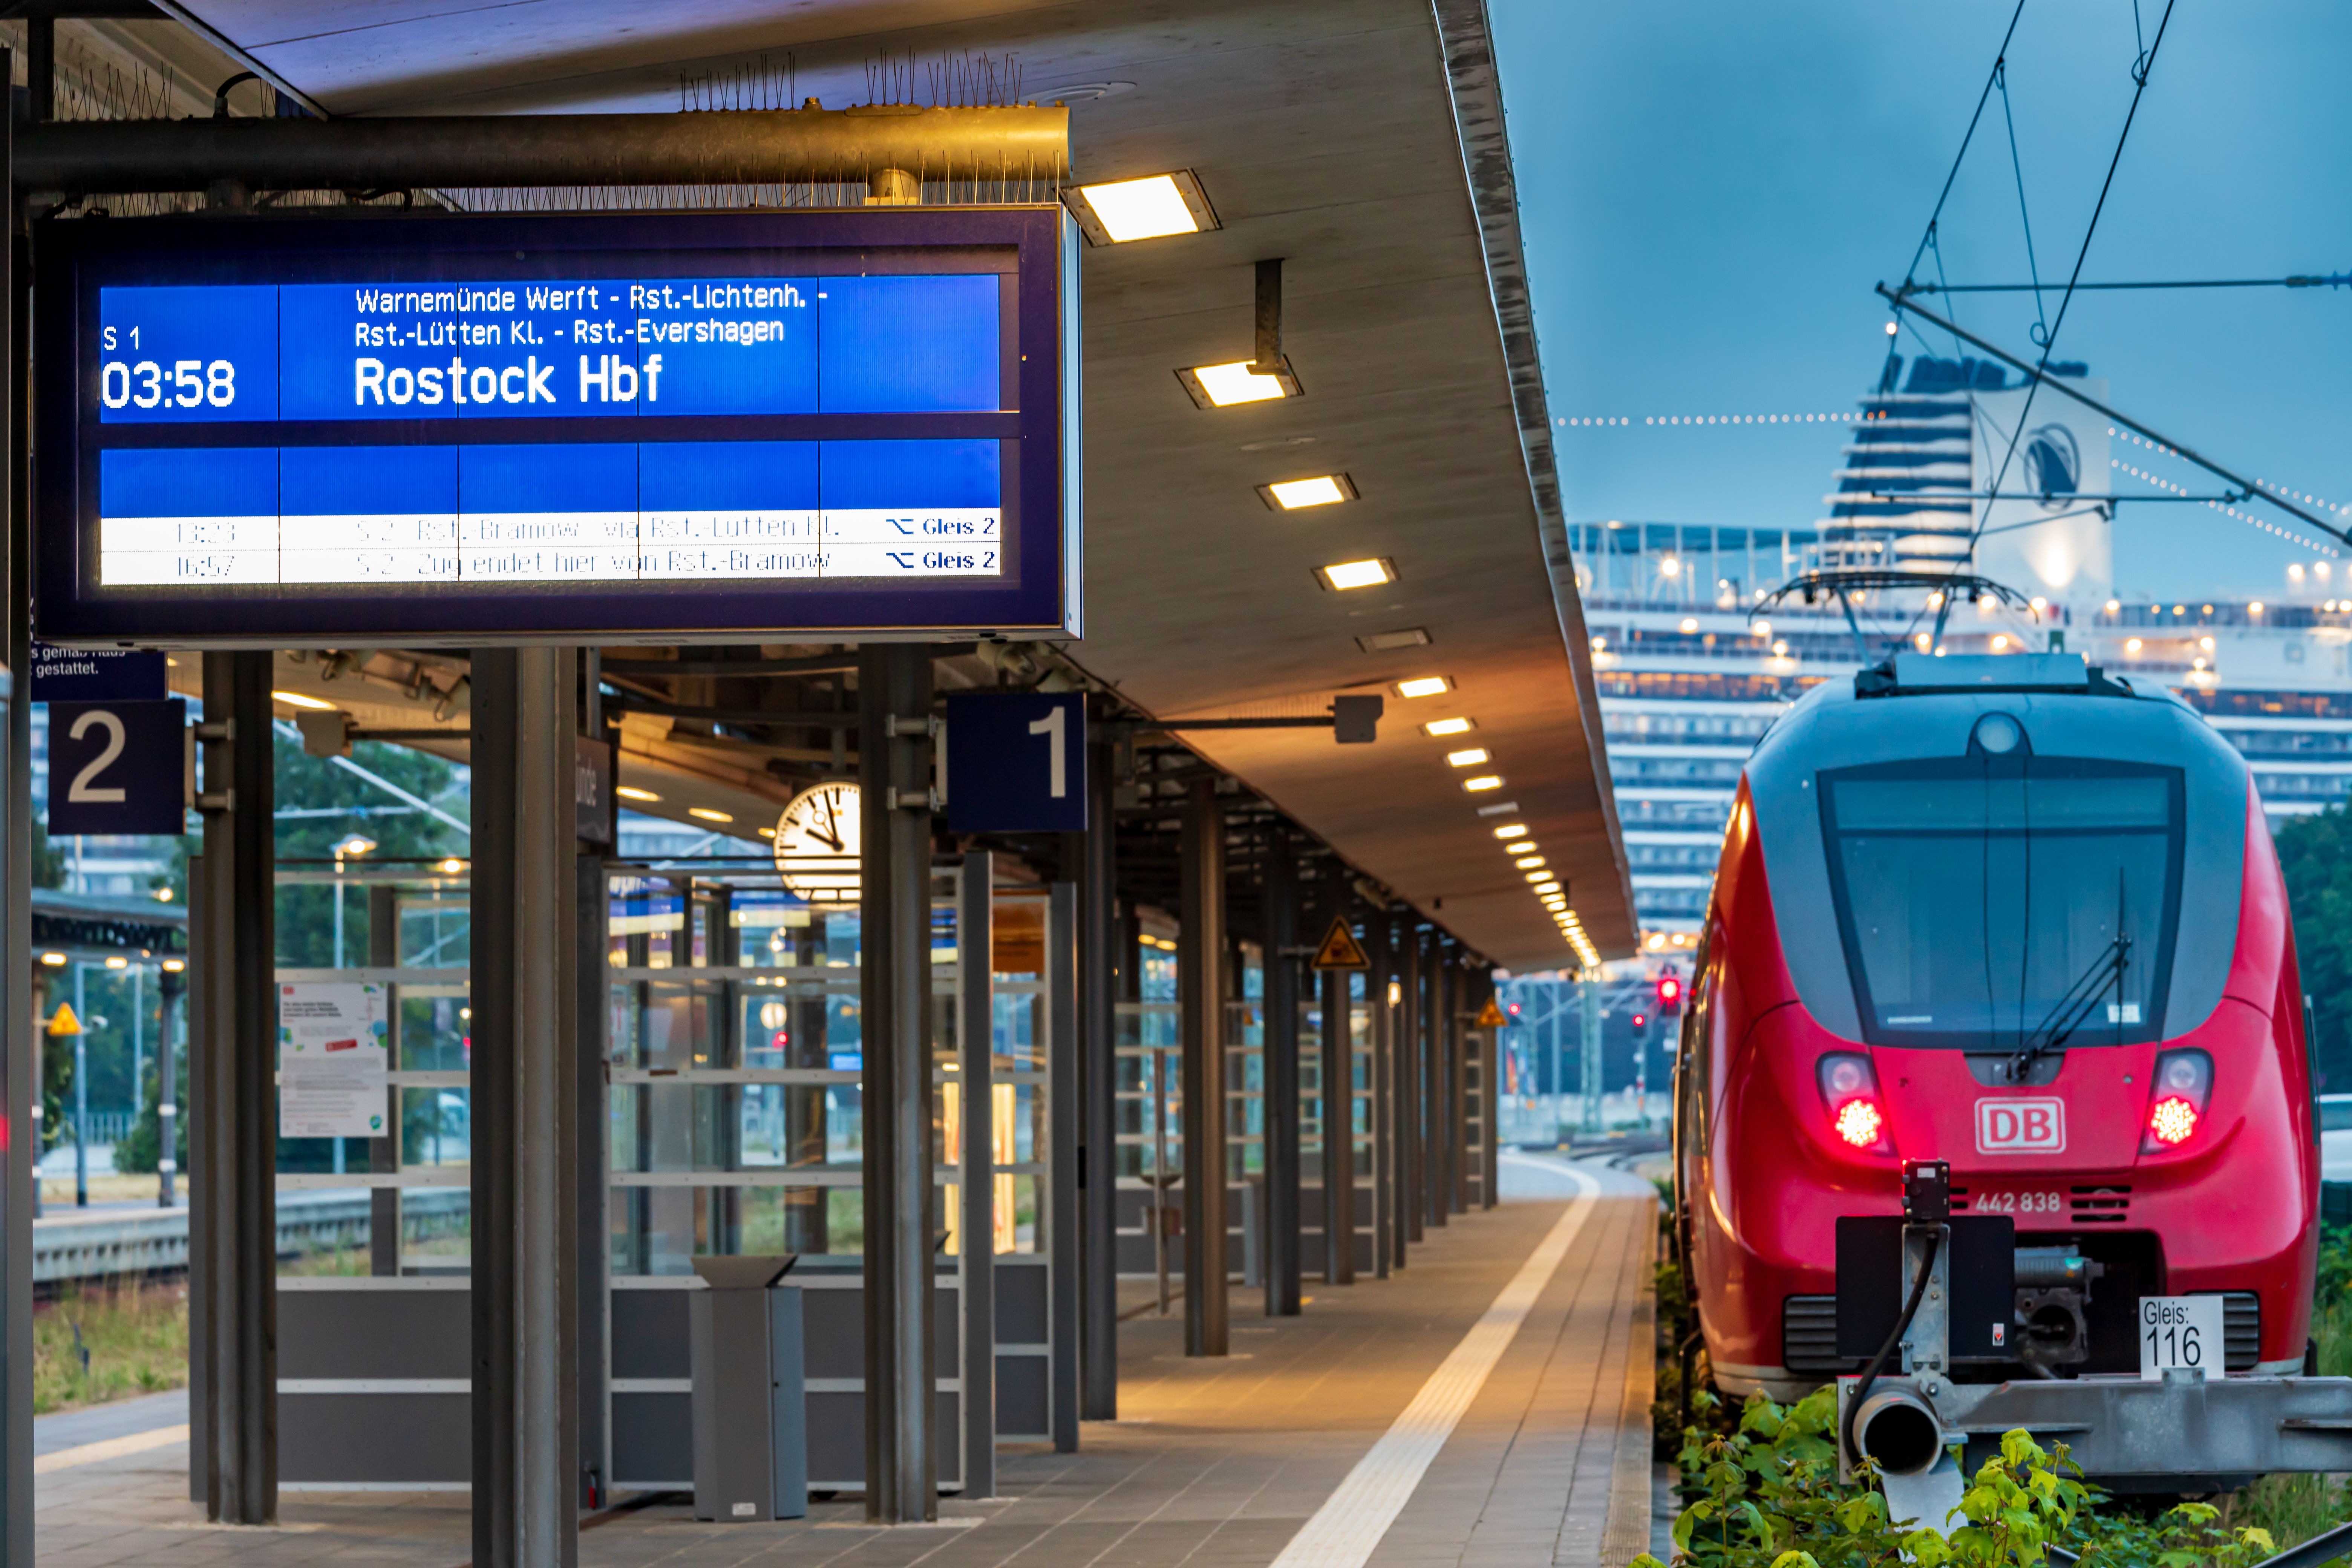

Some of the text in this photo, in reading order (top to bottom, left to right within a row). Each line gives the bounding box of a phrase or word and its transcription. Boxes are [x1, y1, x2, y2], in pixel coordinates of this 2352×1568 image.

[356, 287, 515, 313] Warnemünde
[526, 286, 599, 311] Werft
[630, 283, 805, 309] Rst.-Lichtenh.
[104, 326, 139, 350] S 1
[356, 321, 500, 347] Rst.-Lütten
[511, 320, 543, 344] Kl.
[574, 318, 784, 346] Rst.-Evershagen
[102, 360, 235, 409] 03:58
[356, 354, 662, 405] Rostock Hbf
[923, 518, 995, 534] Gleis 2
[174, 556, 234, 576] 16:57
[419, 554, 461, 577] Zug
[474, 553, 543, 573] endet
[556, 553, 597, 572] hier
[611, 555, 657, 572] von
[669, 550, 830, 571] Rst.-Bramow
[923, 551, 995, 568] Gleis 2
[36, 661, 99, 678] gestattet.
[68, 709, 126, 803] 2
[1029, 706, 1066, 798] 1
[1989, 1108, 2051, 1142] DB
[1976, 1192, 2060, 1213] 442 838
[2144, 1301, 2188, 1325] Gleis:
[2147, 1326, 2200, 1366] 116
